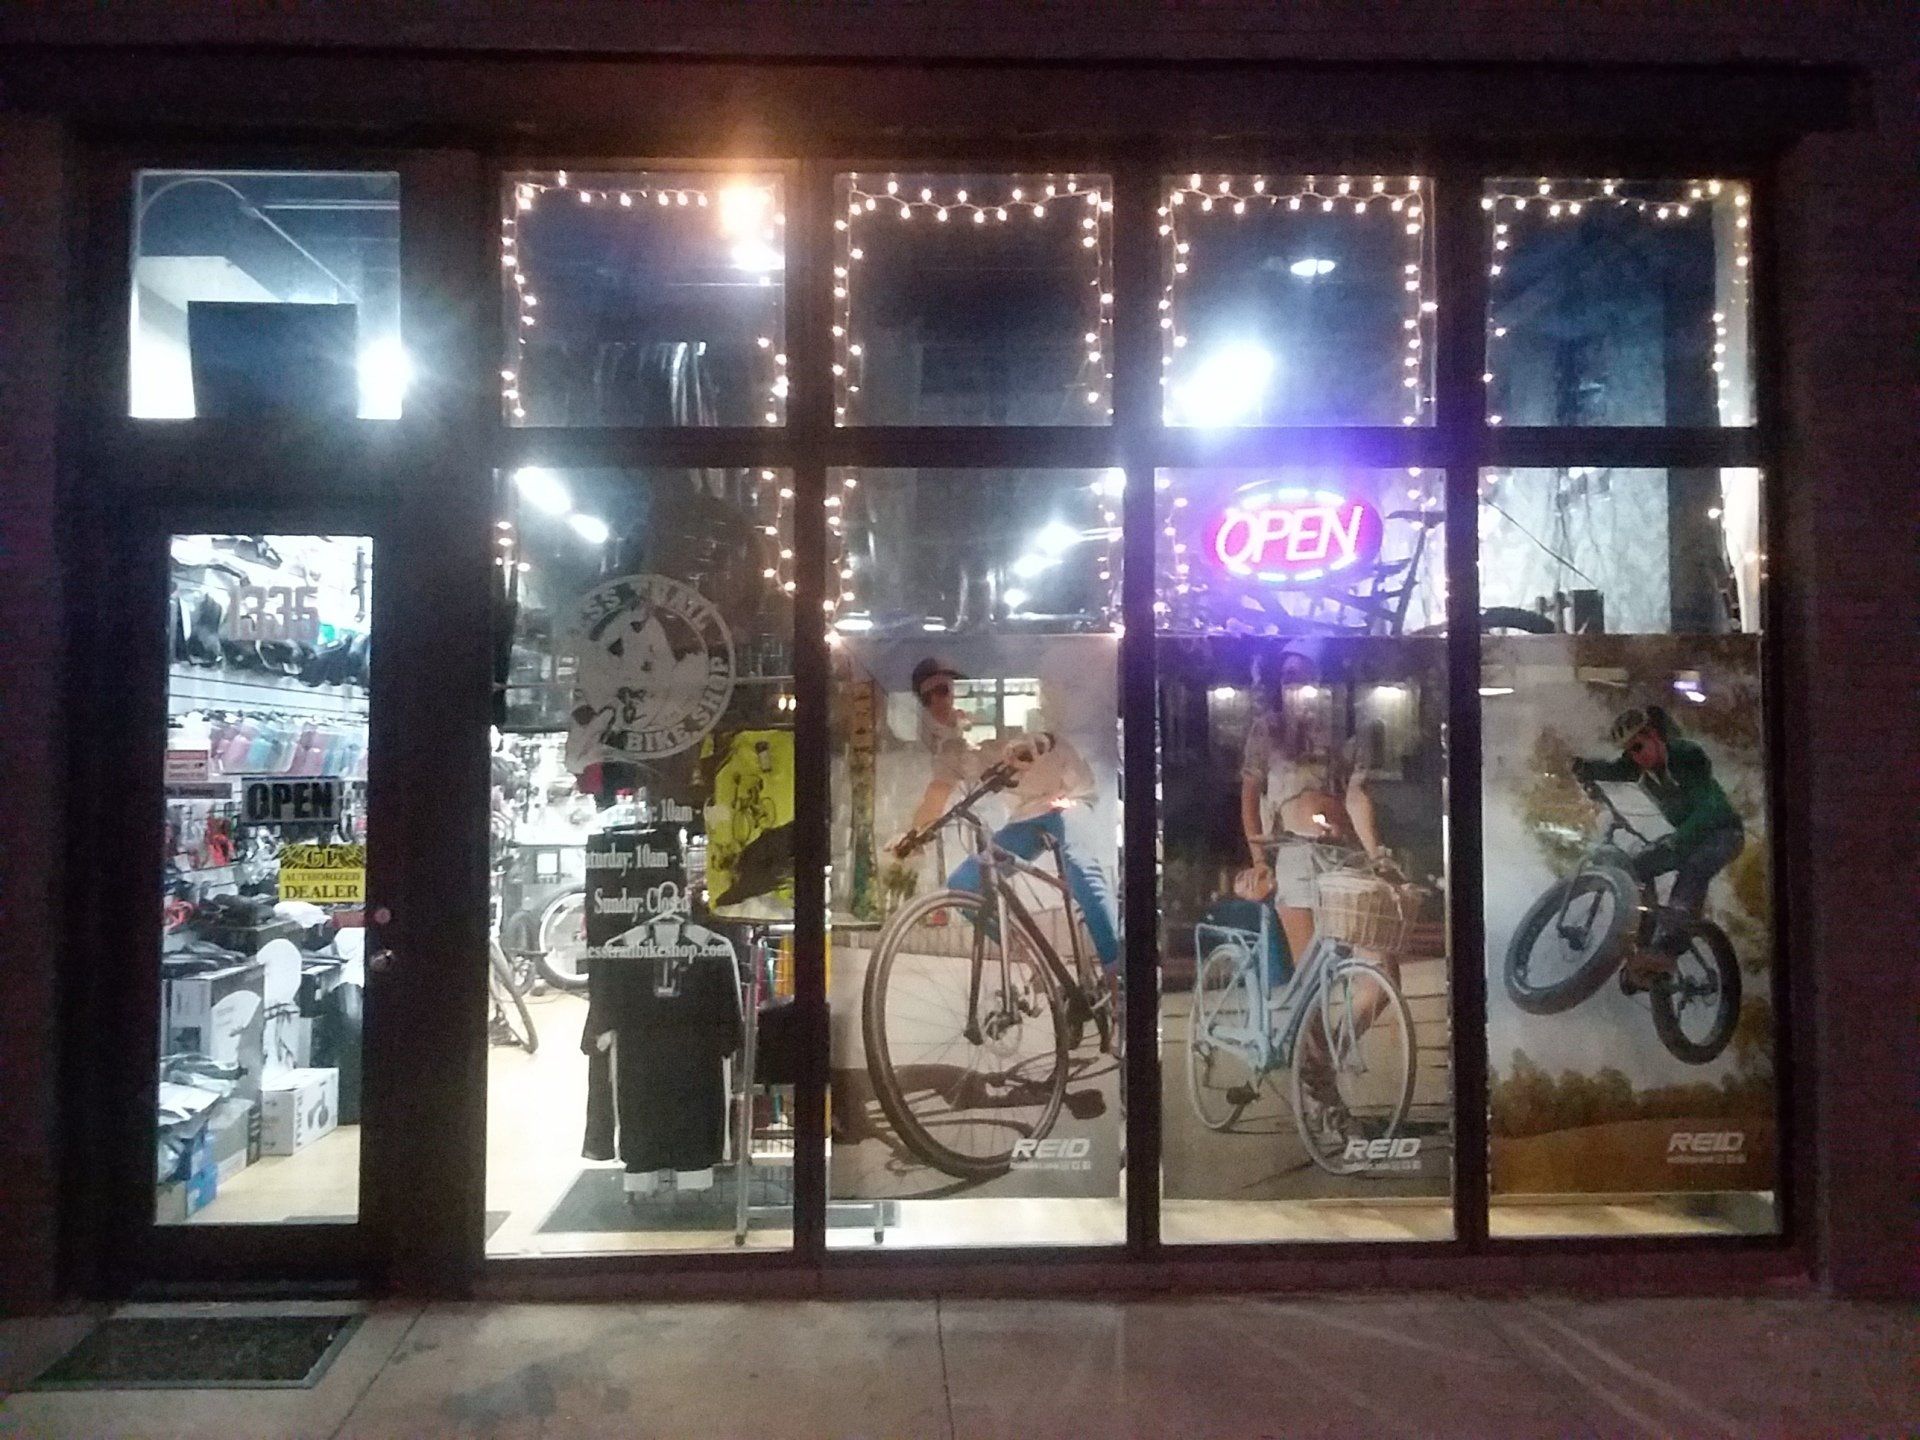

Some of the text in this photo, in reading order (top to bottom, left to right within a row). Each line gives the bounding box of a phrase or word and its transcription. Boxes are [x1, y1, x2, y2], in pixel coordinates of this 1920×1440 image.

[1214, 505, 1364, 565] OPEN
[630, 656, 729, 751] BIKE SHOP
[247, 782, 333, 819] OPEN
[284, 885, 359, 899] DEALER
[1011, 1138, 1090, 1158] REID
[1343, 1137, 1421, 1159] REID
[1670, 1132, 1744, 1152] REID
